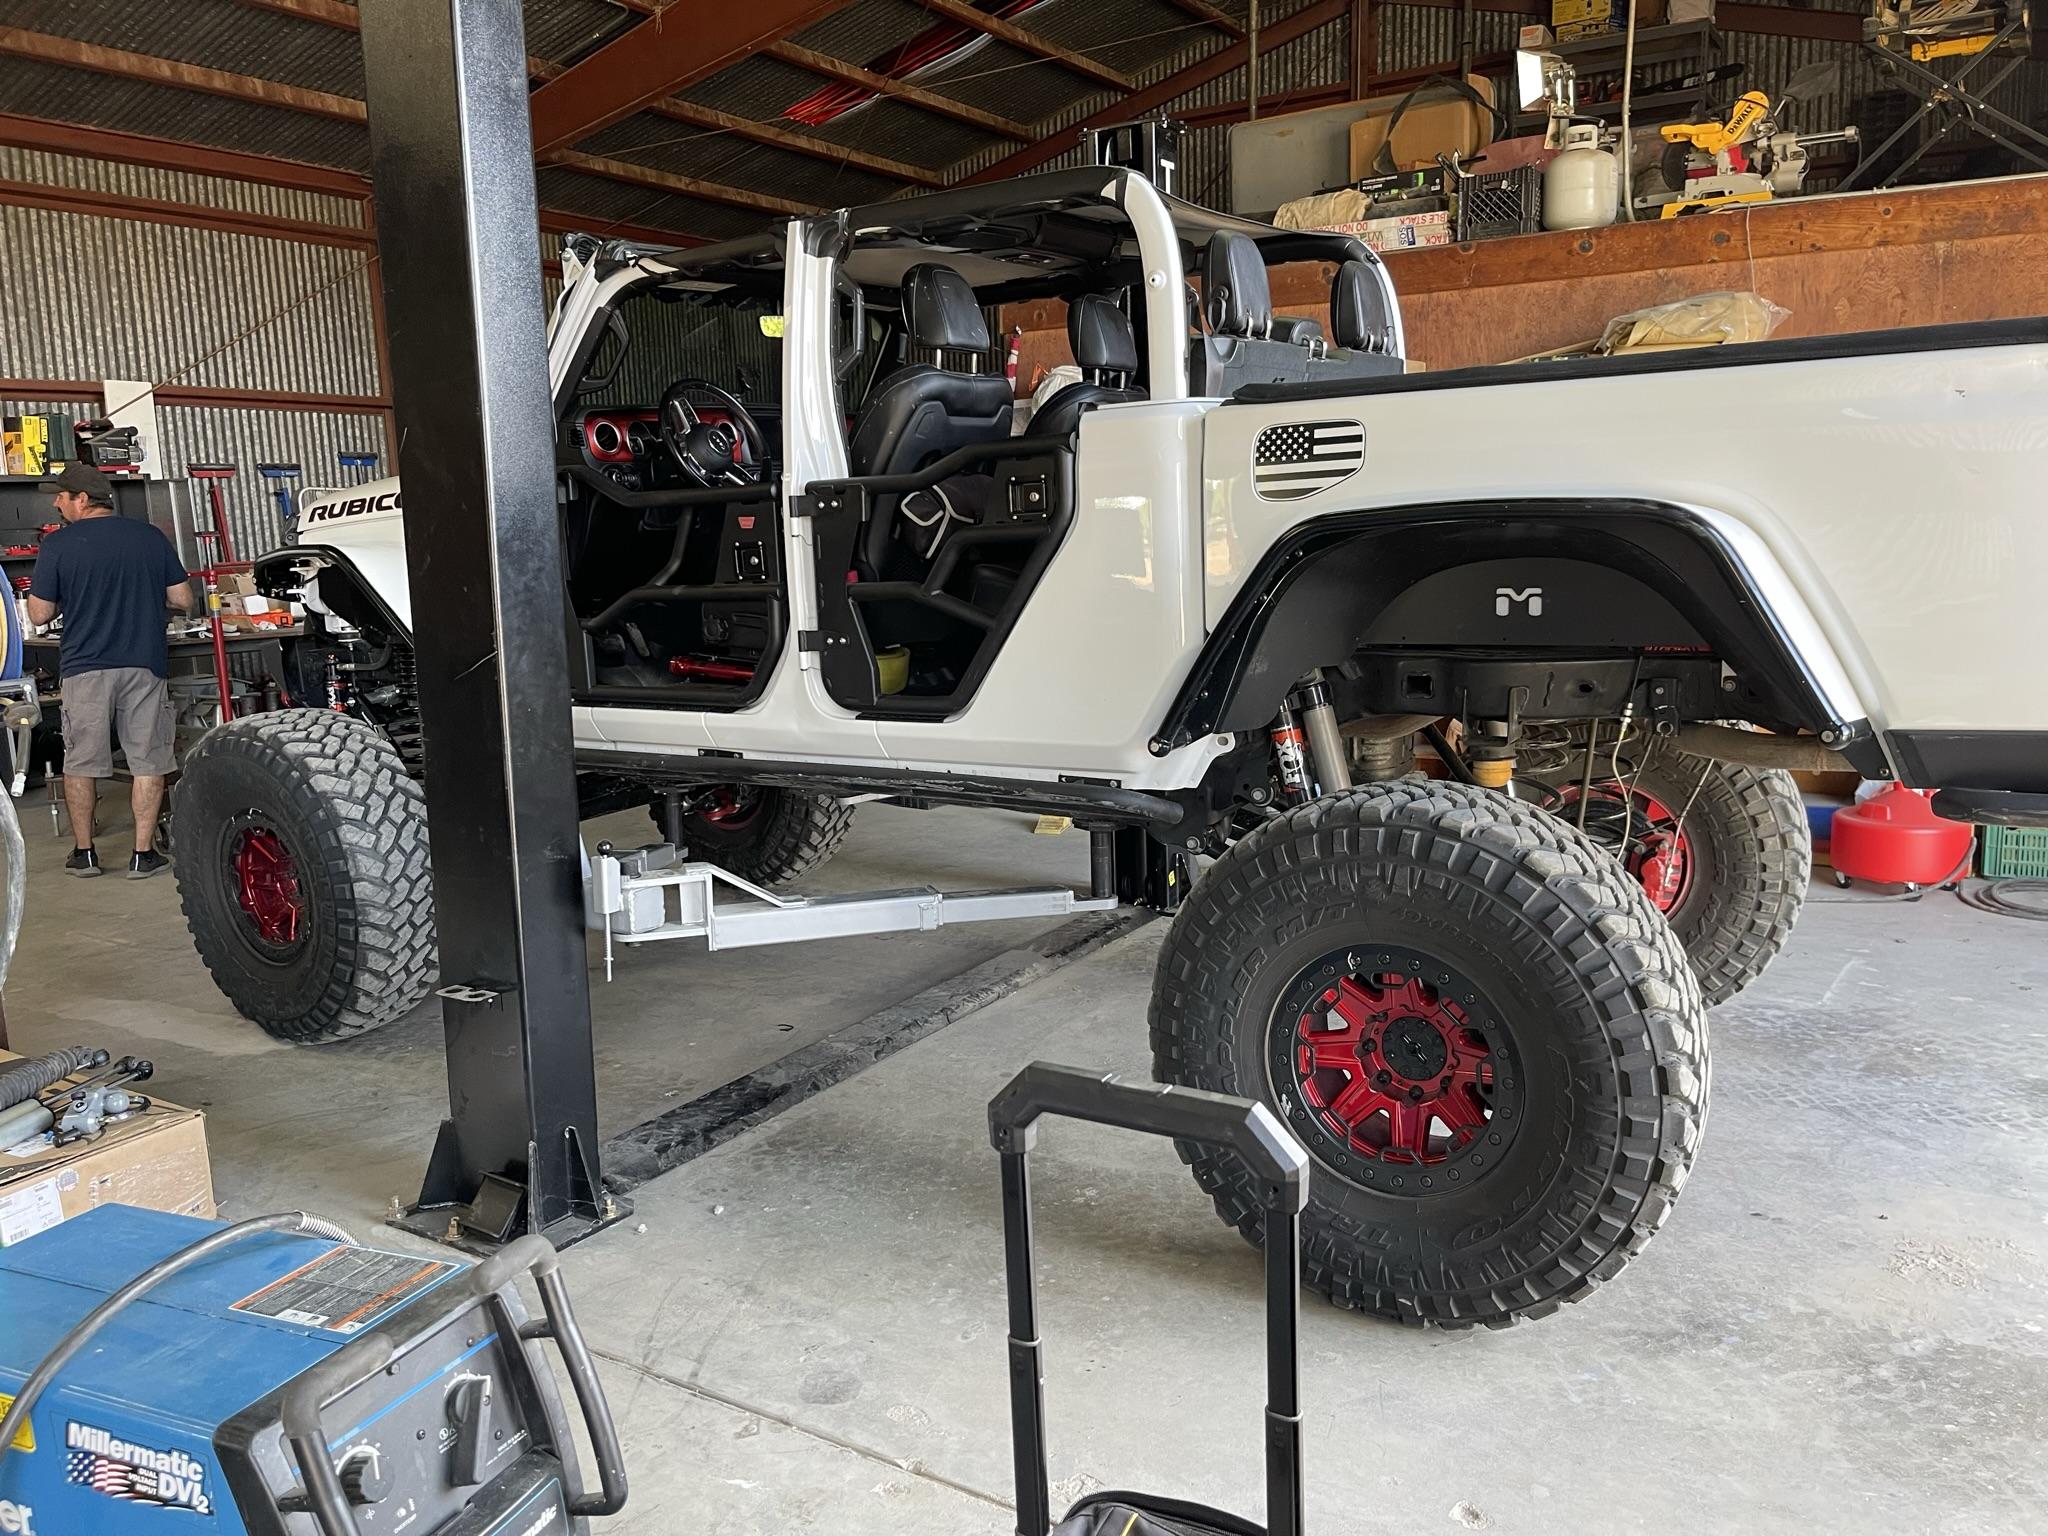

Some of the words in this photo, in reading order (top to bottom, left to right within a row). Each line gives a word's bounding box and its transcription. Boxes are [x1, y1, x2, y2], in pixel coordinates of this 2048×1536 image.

[1727, 104, 1754, 134] DEWALT
[308, 492, 402, 523] RUBIC
[1276, 738, 1303, 785] FOX
[1217, 946, 1268, 1097] APPLER
[68, 1421, 203, 1482] Millermatic
